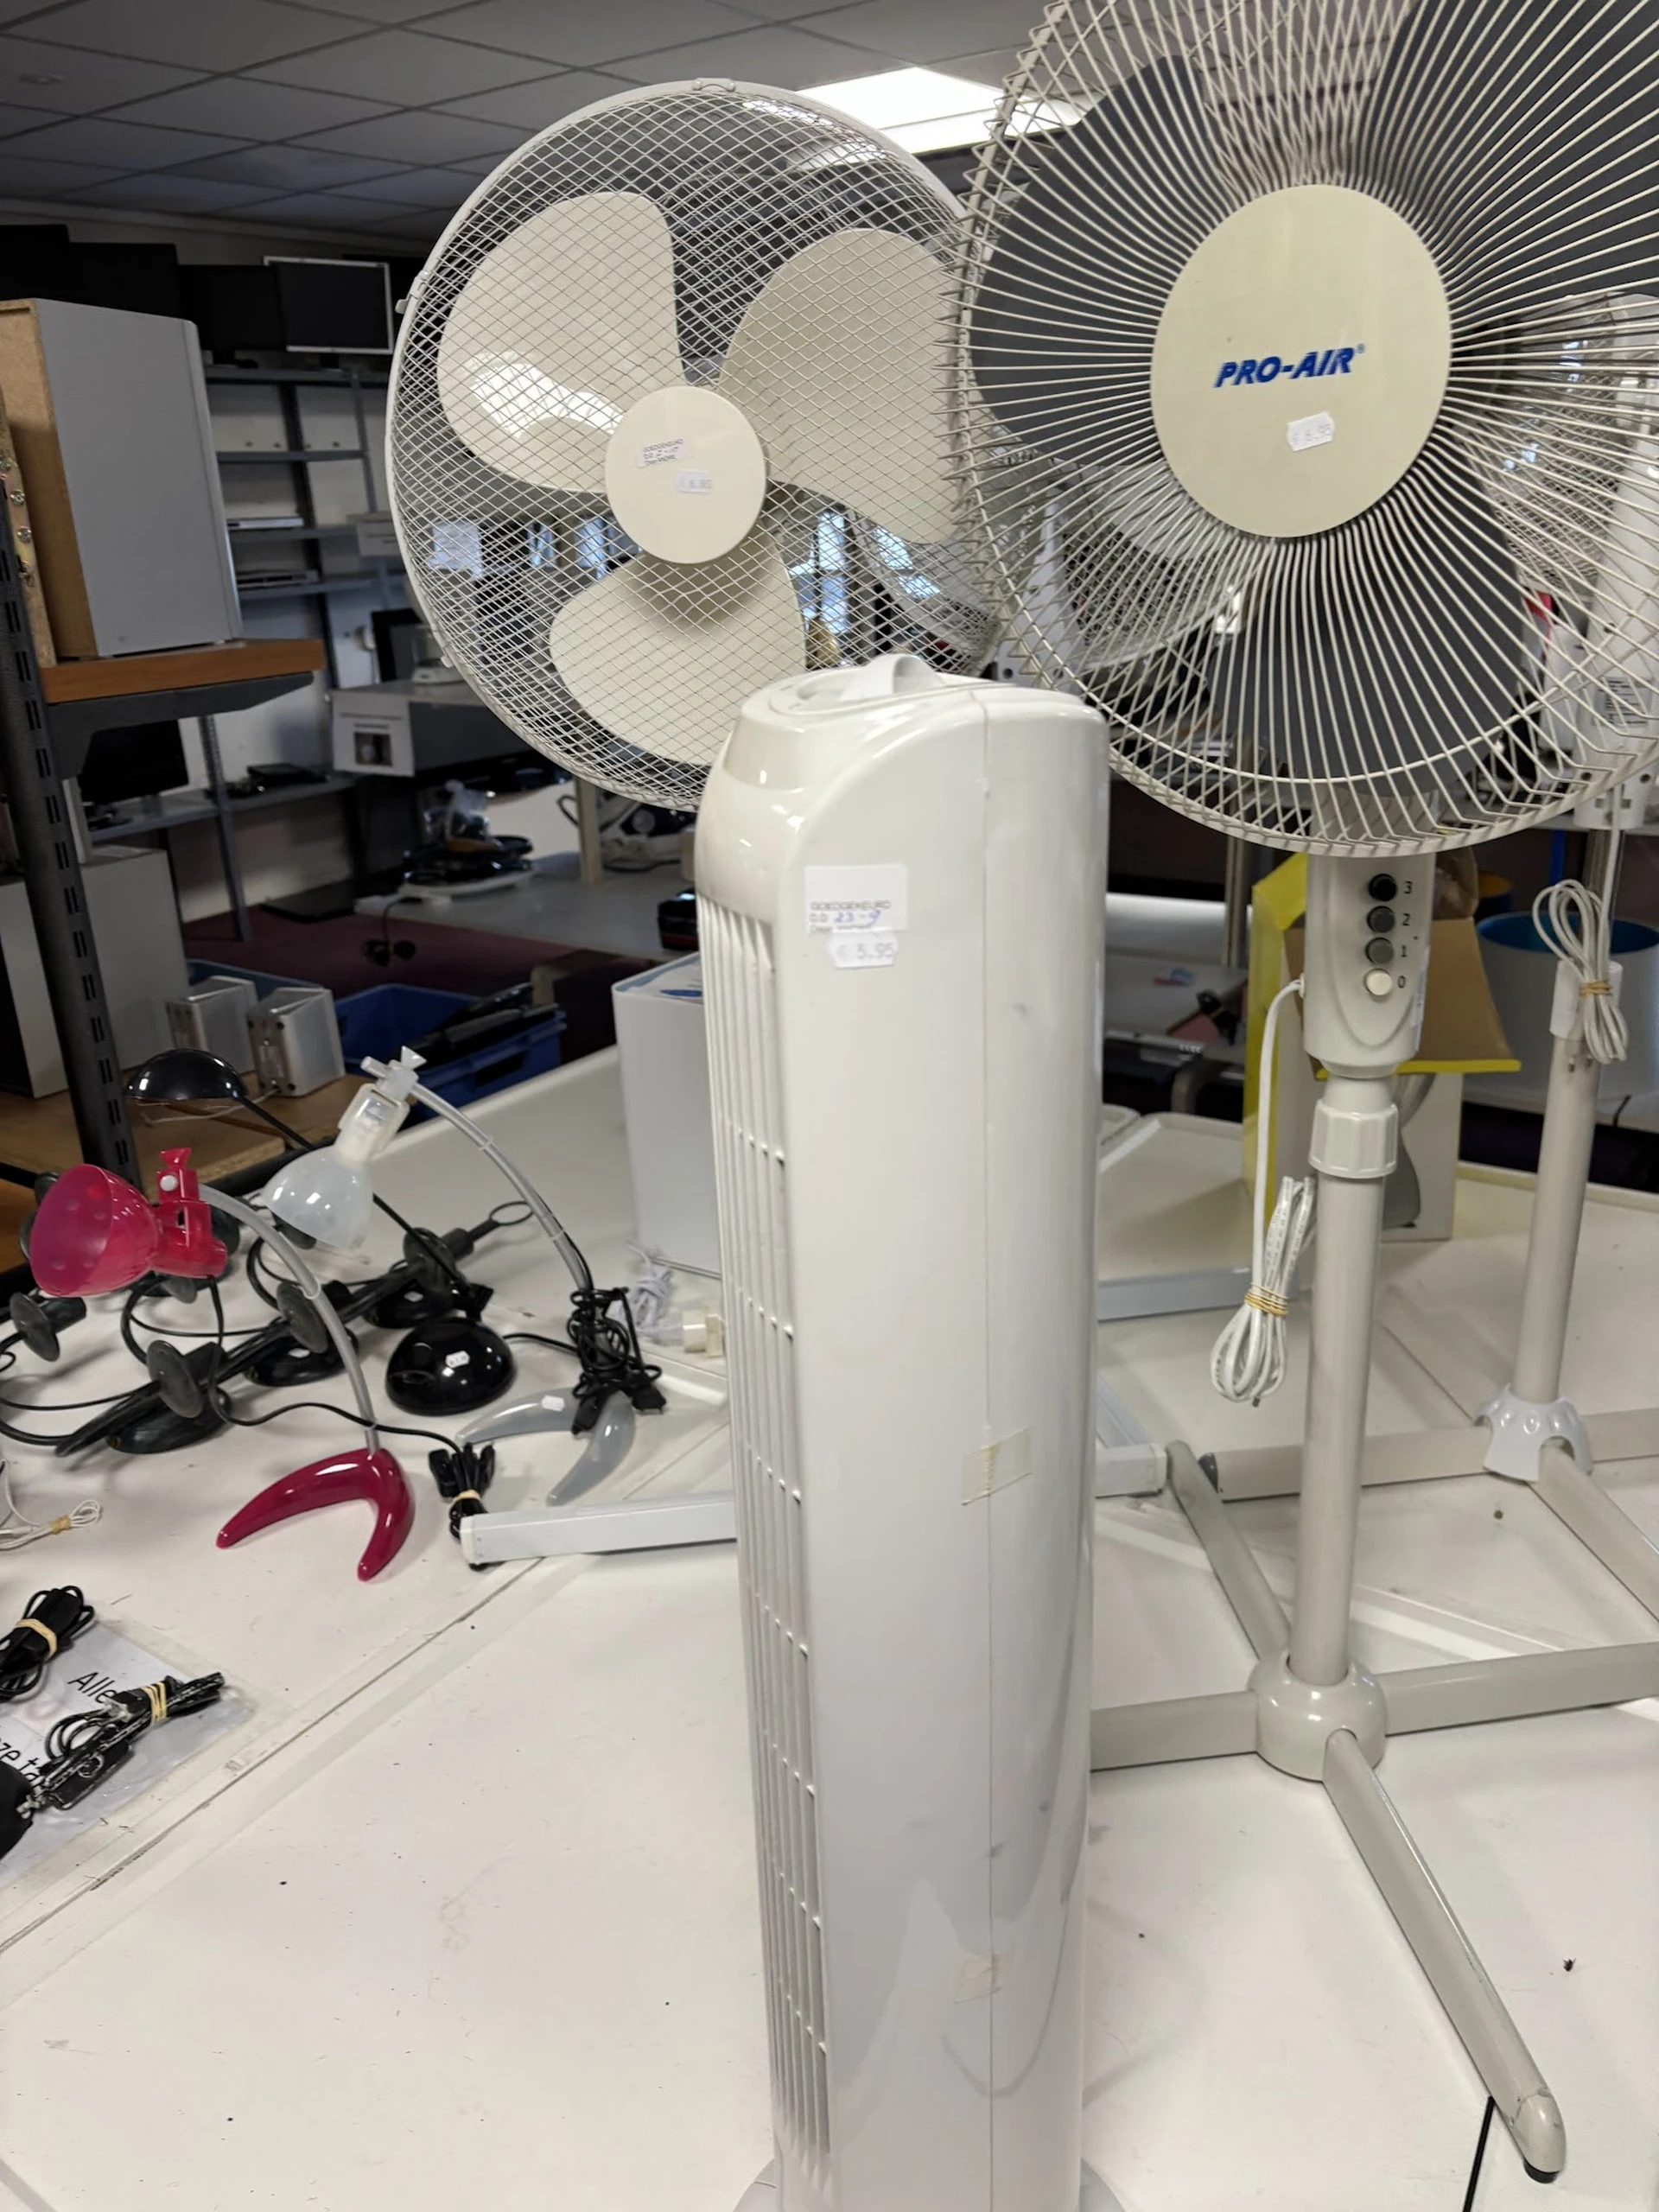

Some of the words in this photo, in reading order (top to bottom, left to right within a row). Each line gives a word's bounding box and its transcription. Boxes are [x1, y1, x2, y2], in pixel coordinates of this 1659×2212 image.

[1212, 346, 1355, 388] PRO-AIR
[1403, 880, 1413, 894] 3
[1402, 912, 1411, 926] 2
[1400, 944, 1408, 958] 1
[1396, 975, 1407, 989] 0
